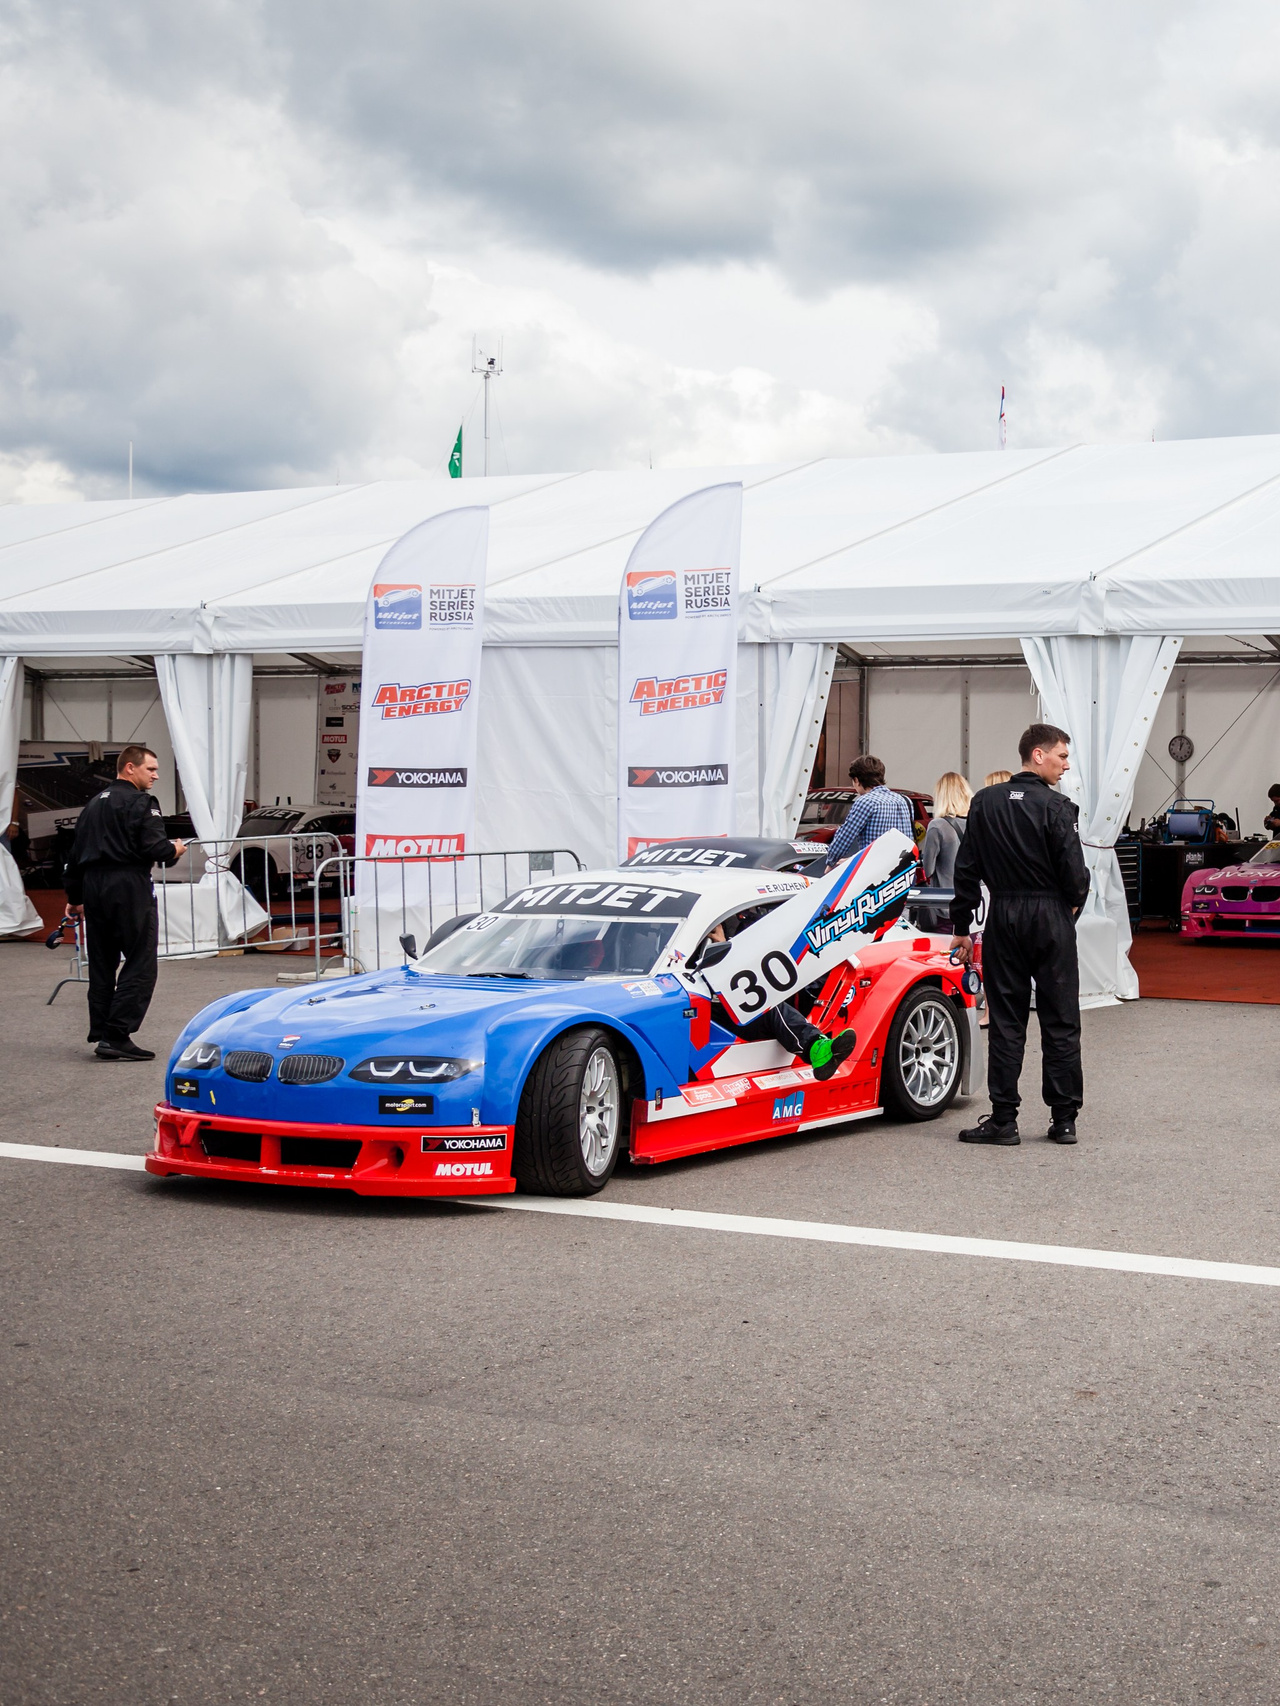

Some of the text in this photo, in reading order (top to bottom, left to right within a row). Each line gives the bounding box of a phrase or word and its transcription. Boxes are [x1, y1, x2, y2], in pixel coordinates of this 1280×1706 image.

[684, 572, 731, 585] MITJET
[429, 588, 476, 599] MITJET
[684, 585, 731, 598] SERIES
[430, 600, 474, 611] SERIES
[685, 597, 730, 609] RUSSIA
[430, 612, 473, 621] RUSSIA
[376, 682, 469, 704] ARCTIC
[633, 672, 727, 700] ARCTIC
[384, 698, 464, 718] ENERGY
[642, 690, 724, 714] ENERGY
[396, 772, 464, 784] YOKOHAMA
[656, 769, 724, 783] YOKOHAMA
[306, 844, 324, 860] 83
[370, 838, 461, 859] MOTUL
[629, 848, 747, 868] MITJET
[503, 884, 682, 912] MITJET
[466, 916, 499, 930] 30
[730, 950, 799, 1013] 30
[772, 1103, 802, 1120] AMG
[444, 1138, 503, 1149] YOKOHAMA
[435, 1162, 493, 1177] MOTUL
